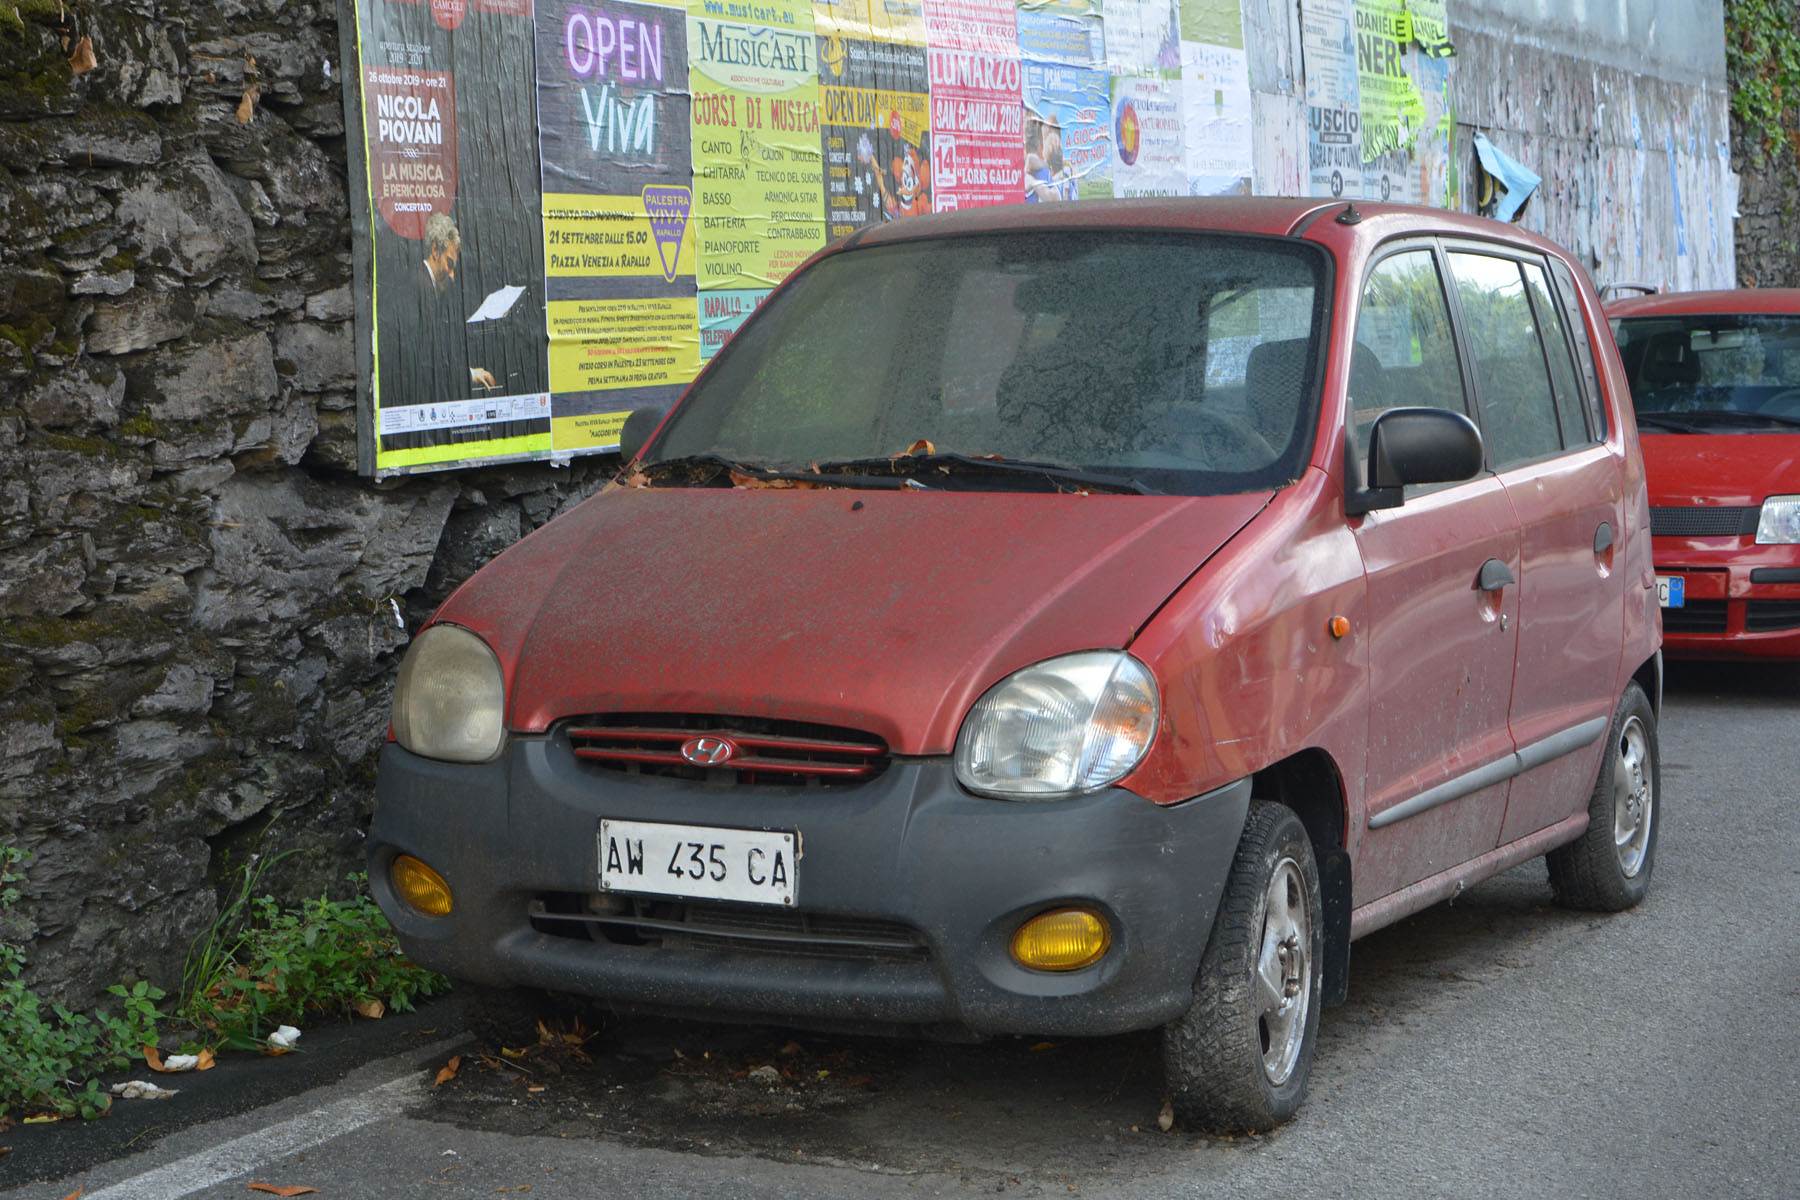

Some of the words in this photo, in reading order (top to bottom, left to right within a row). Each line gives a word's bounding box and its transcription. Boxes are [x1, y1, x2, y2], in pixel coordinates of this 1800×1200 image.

[704, 0, 795, 24] www.musicart.eu
[566, 12, 662, 82] OPEN
[368, 71, 378, 82] 26
[379, 72, 402, 84] ottobre
[403, 74, 420, 86] 2019
[425, 79, 438, 88] ore
[438, 77, 446, 88] 21
[933, 52, 1020, 91] LUMARZO
[377, 94, 441, 120] NICOLA
[693, 91, 736, 127] CORSI
[745, 96, 763, 129] DI
[770, 98, 820, 133] MUSICA
[825, 88, 854, 122] OPEN
[857, 91, 876, 124] DAY
[936, 99, 957, 130] SAN
[958, 101, 997, 133] CAMILLO
[999, 104, 1021, 134] 2019
[1076, 109, 1097, 124] VIENI
[1312, 106, 1359, 133] USCIO
[378, 119, 442, 144] PIOVANI
[1065, 133, 1072, 148] A
[1073, 125, 1108, 146] GIOCARE
[702, 140, 732, 154] CANTO
[761, 149, 785, 161] CAJON
[935, 145, 955, 174] 14
[1070, 149, 1089, 166] CON
[382, 162, 397, 180] LA
[399, 163, 444, 181] MUSICA
[703, 166, 746, 180] CHITARRA
[756, 170, 785, 183] TECNICO
[787, 171, 800, 183] DEL
[801, 173, 823, 184] SUONO
[383, 180, 390, 197] È
[391, 183, 446, 198] PERICOLOSA
[645, 194, 690, 206] PALESTRA
[703, 192, 732, 205] BASSO
[764, 192, 799, 203] ARMONICA
[800, 192, 818, 203] SITAR
[394, 202, 433, 212] CONCERTATO
[649, 208, 685, 224] VIVA
[704, 217, 746, 229] BATTERIA
[770, 211, 813, 222] PERCUSSIONI
[549, 230, 560, 243] 21
[561, 231, 603, 244] SETTEMBRE
[604, 232, 625, 244] DALLE
[626, 231, 648, 244] 15.00
[656, 229, 682, 237] RAPALLO
[767, 227, 820, 240] CONTRABBASSO
[704, 241, 760, 253] PIANOFORTE
[705, 263, 742, 275] VIOLINO
[704, 296, 741, 318] RAPALLO
[578, 362, 594, 371] INIZIO
[594, 361, 608, 370] CORSI
[642, 357, 667, 368] SETTEMBRE
[588, 376, 602, 385] PRIMA
[603, 374, 628, 384] SETTIMANA
[634, 373, 647, 382] PROVA
[648, 372, 668, 381] GRATUITA
[1656, 583, 1668, 602] C
[606, 836, 644, 875] AW
[667, 841, 726, 882] 435
[747, 847, 788, 888] CA
